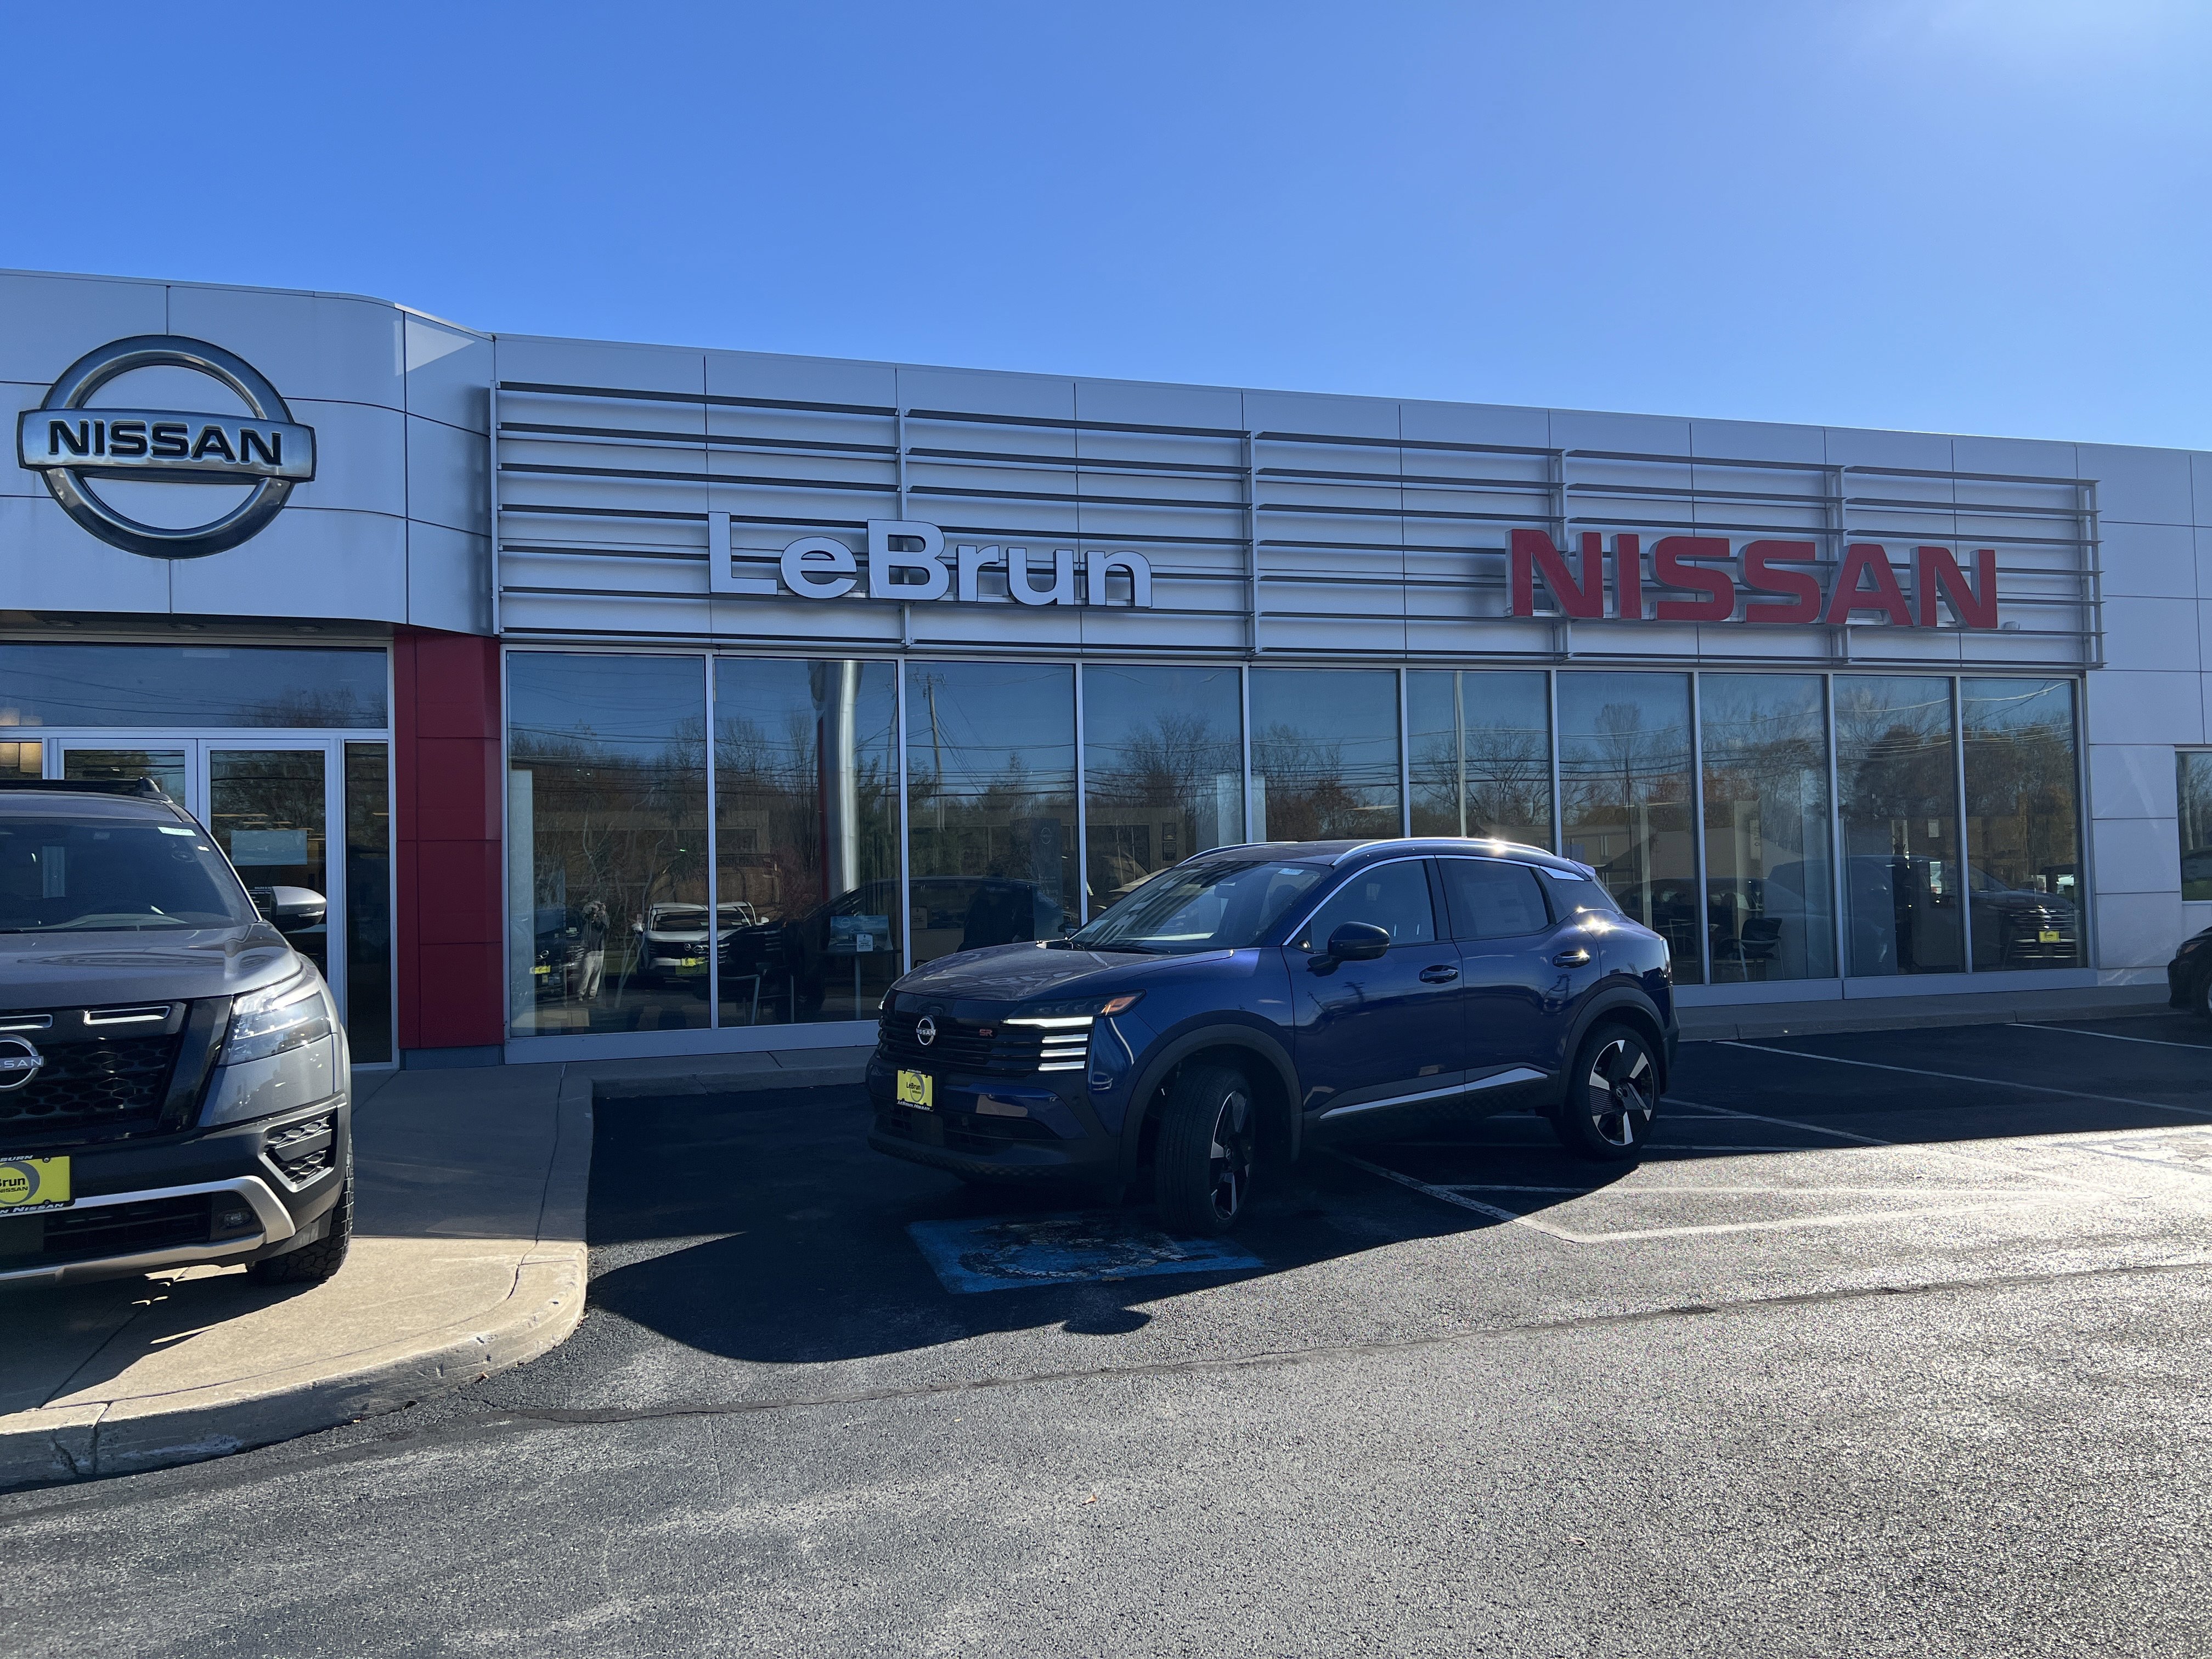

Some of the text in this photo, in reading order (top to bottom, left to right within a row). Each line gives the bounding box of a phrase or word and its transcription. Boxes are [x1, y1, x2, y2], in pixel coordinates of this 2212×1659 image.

[49, 420, 283, 466] NISSAN
[708, 511, 1153, 608] LeBrun
[1506, 529, 1999, 629] NISSAN
[979, 1029, 993, 1037] SR
[0, 1058, 42, 1069] SAN
[906, 1081, 921, 1091] LeBrun
[13, 1203, 64, 1213] NISSAN
